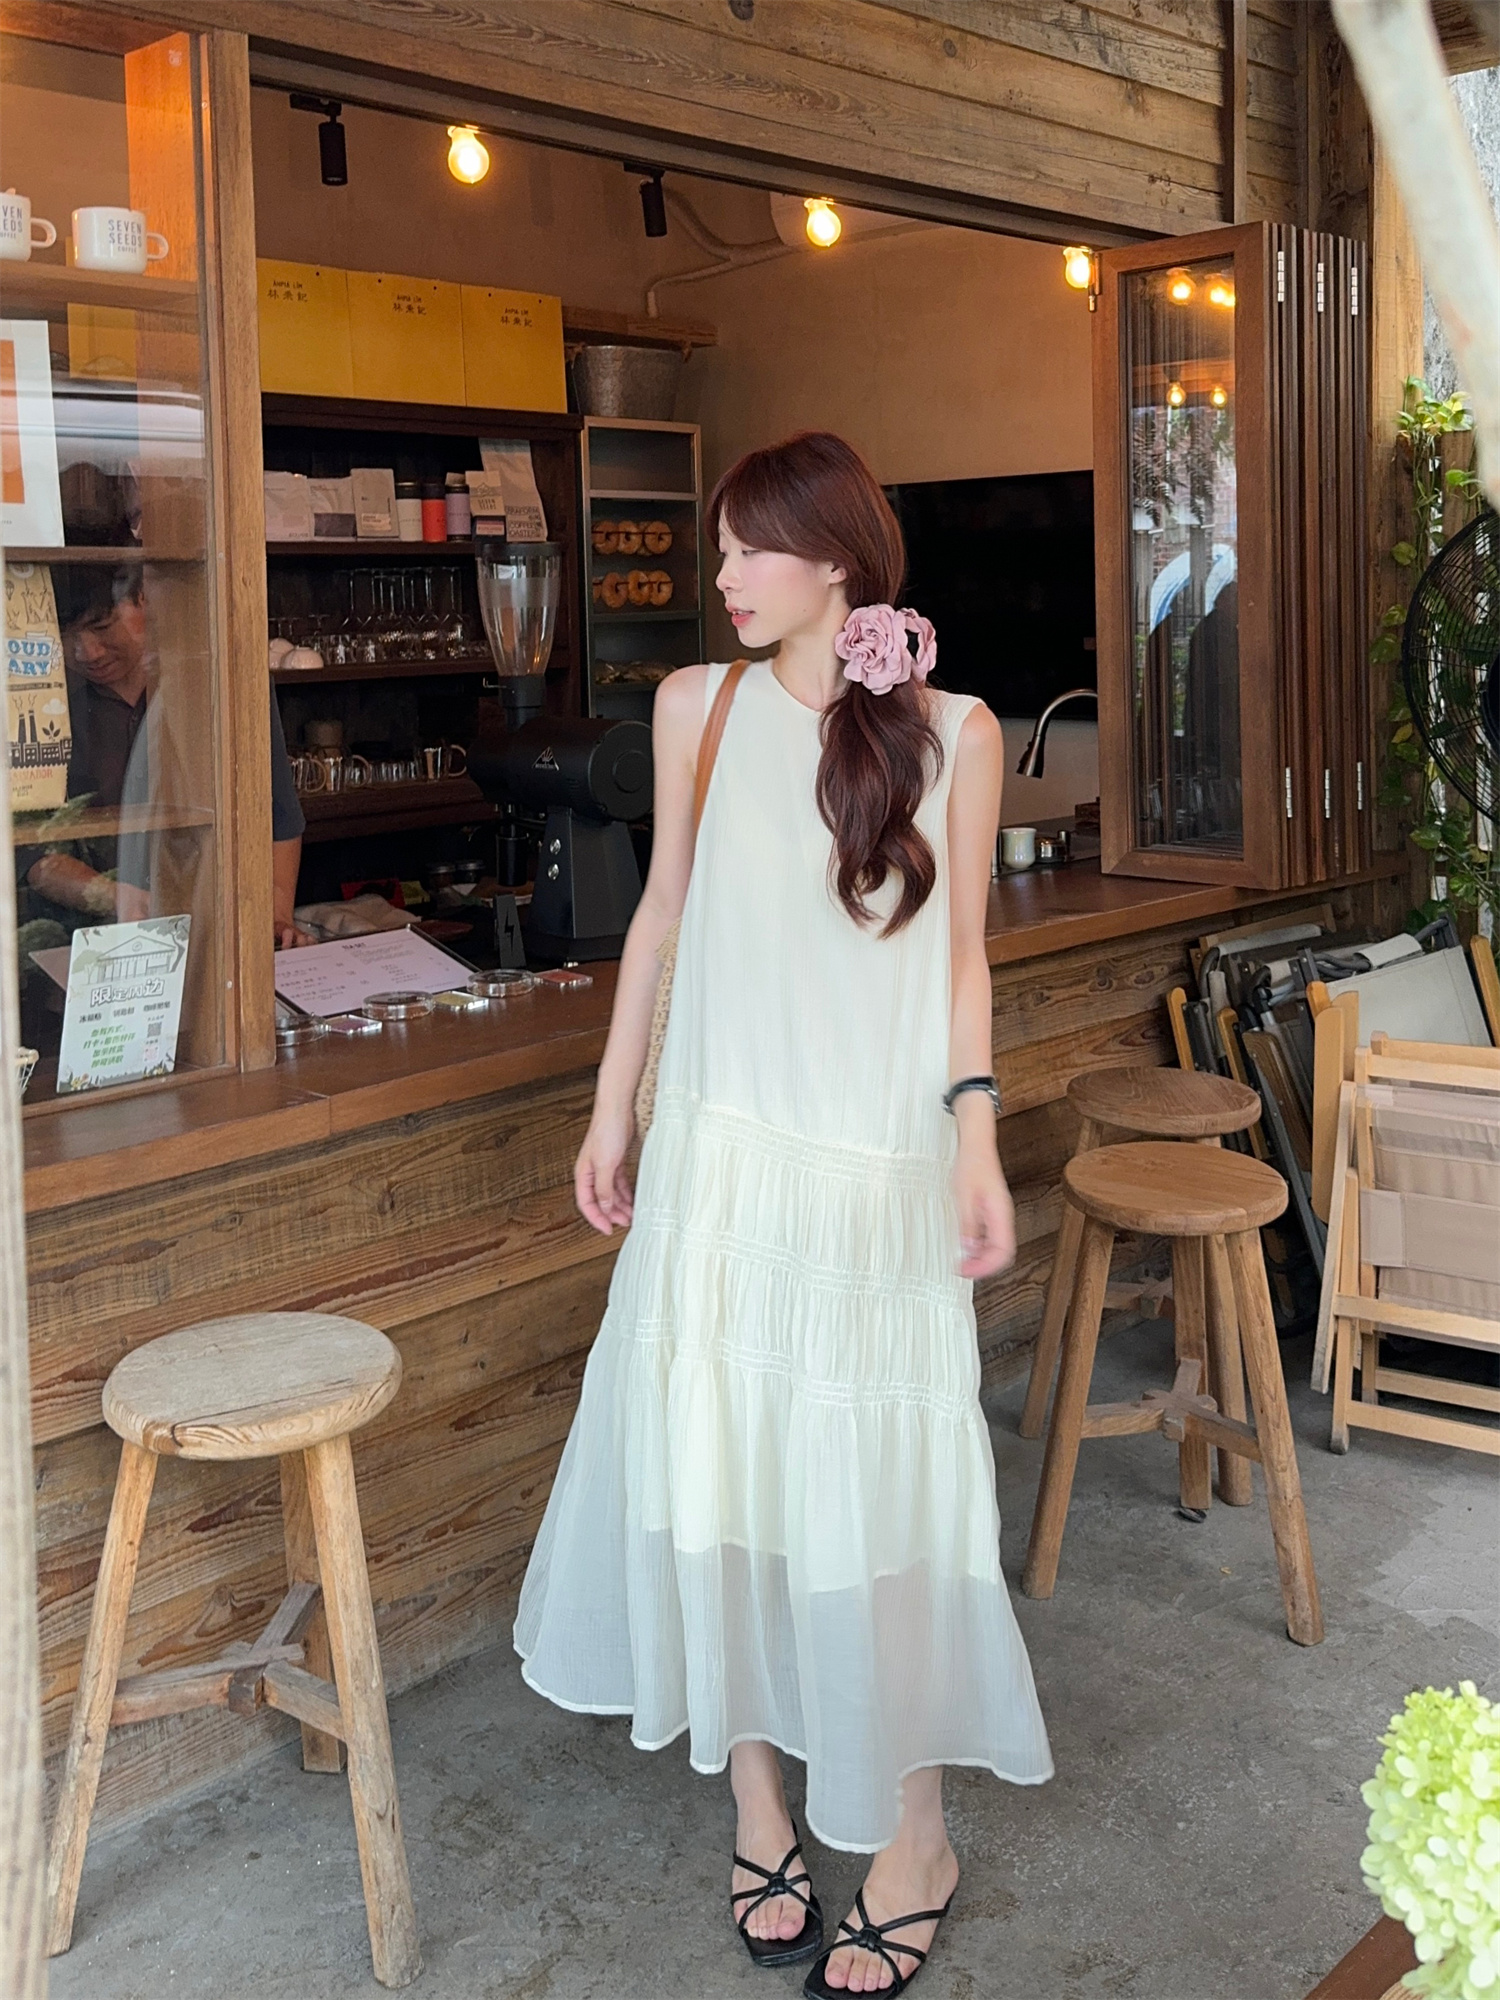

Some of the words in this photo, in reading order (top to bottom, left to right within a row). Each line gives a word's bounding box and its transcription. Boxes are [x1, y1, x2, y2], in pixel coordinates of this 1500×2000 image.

[108, 219, 142, 234] SEVEN
[108, 234, 142, 248] SEEDS
[90, 978, 165, 1008] 限定周边
